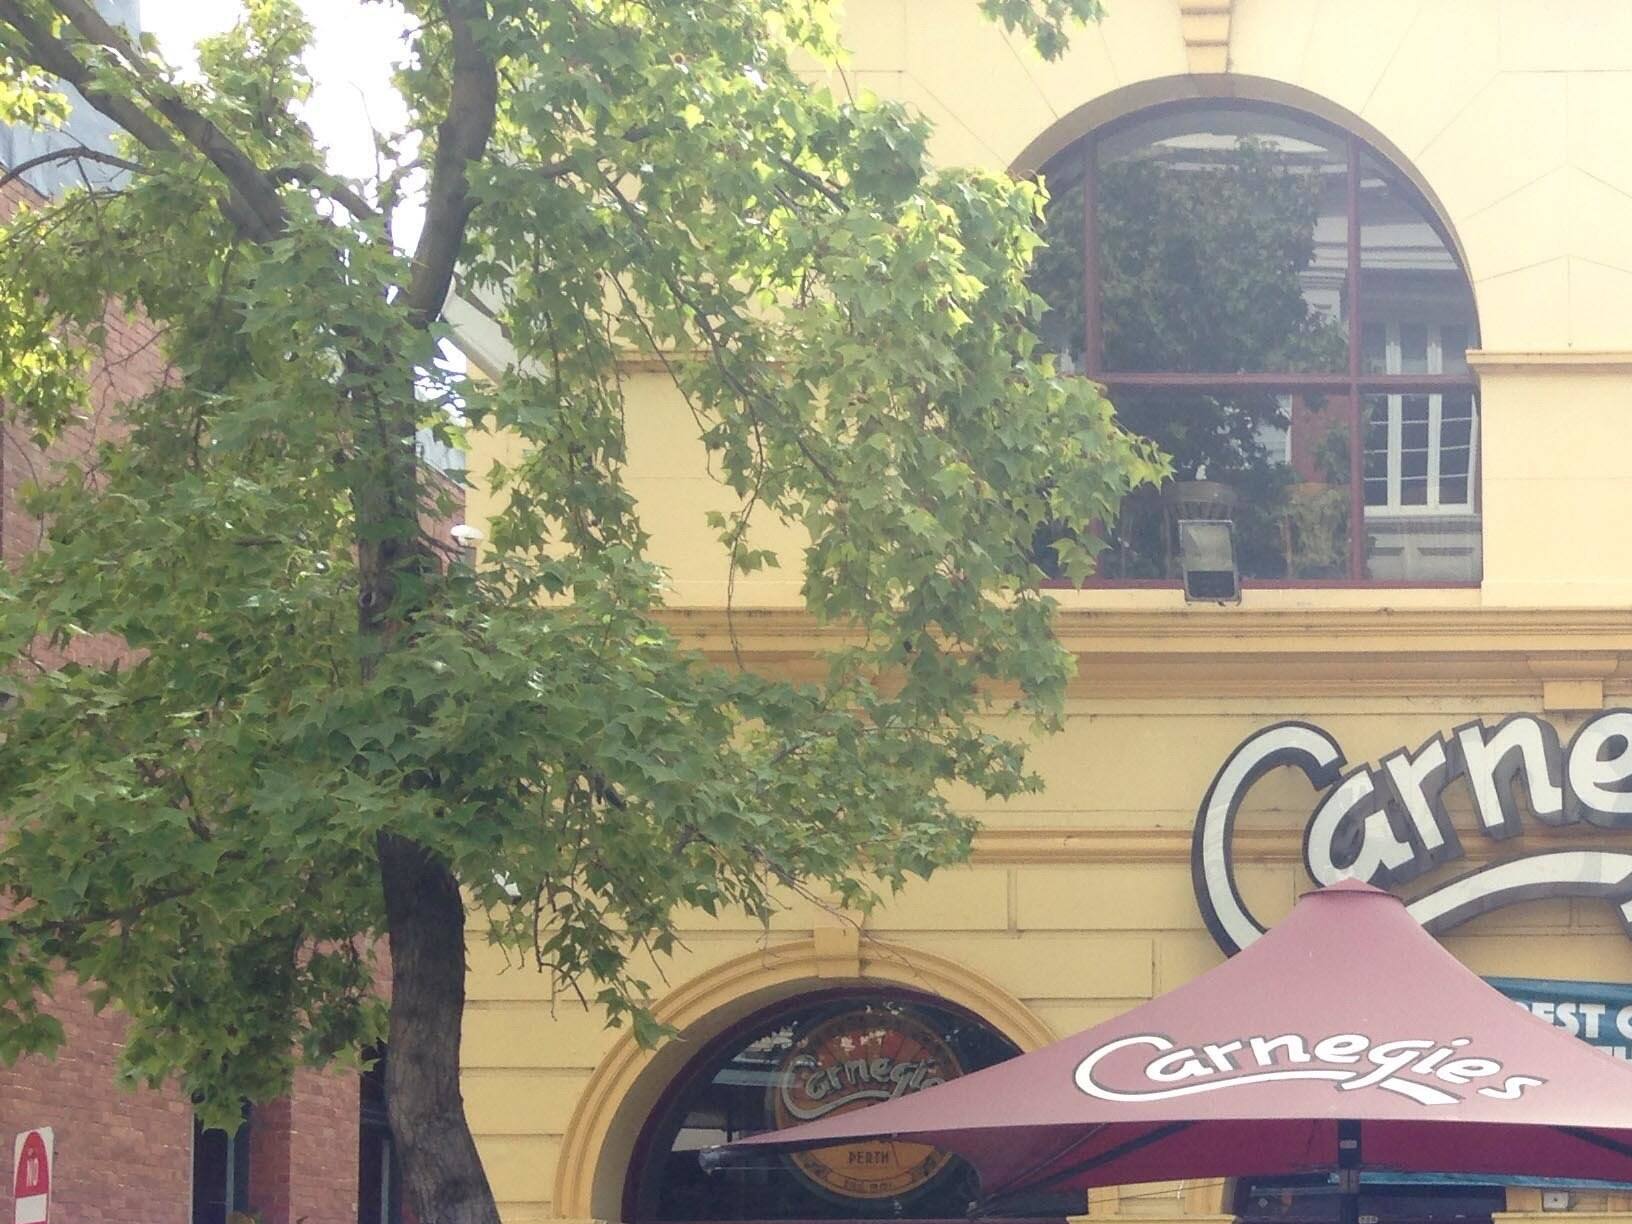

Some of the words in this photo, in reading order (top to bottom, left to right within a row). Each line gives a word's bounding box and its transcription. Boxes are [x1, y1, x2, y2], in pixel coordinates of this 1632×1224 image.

[1518, 1003, 1605, 1038] EST
[780, 1053, 949, 1121] Carnegi
[1072, 1032, 1550, 1107] Carnegies
[26, 1158, 39, 1188] NO
[848, 1151, 889, 1165] PERTH
